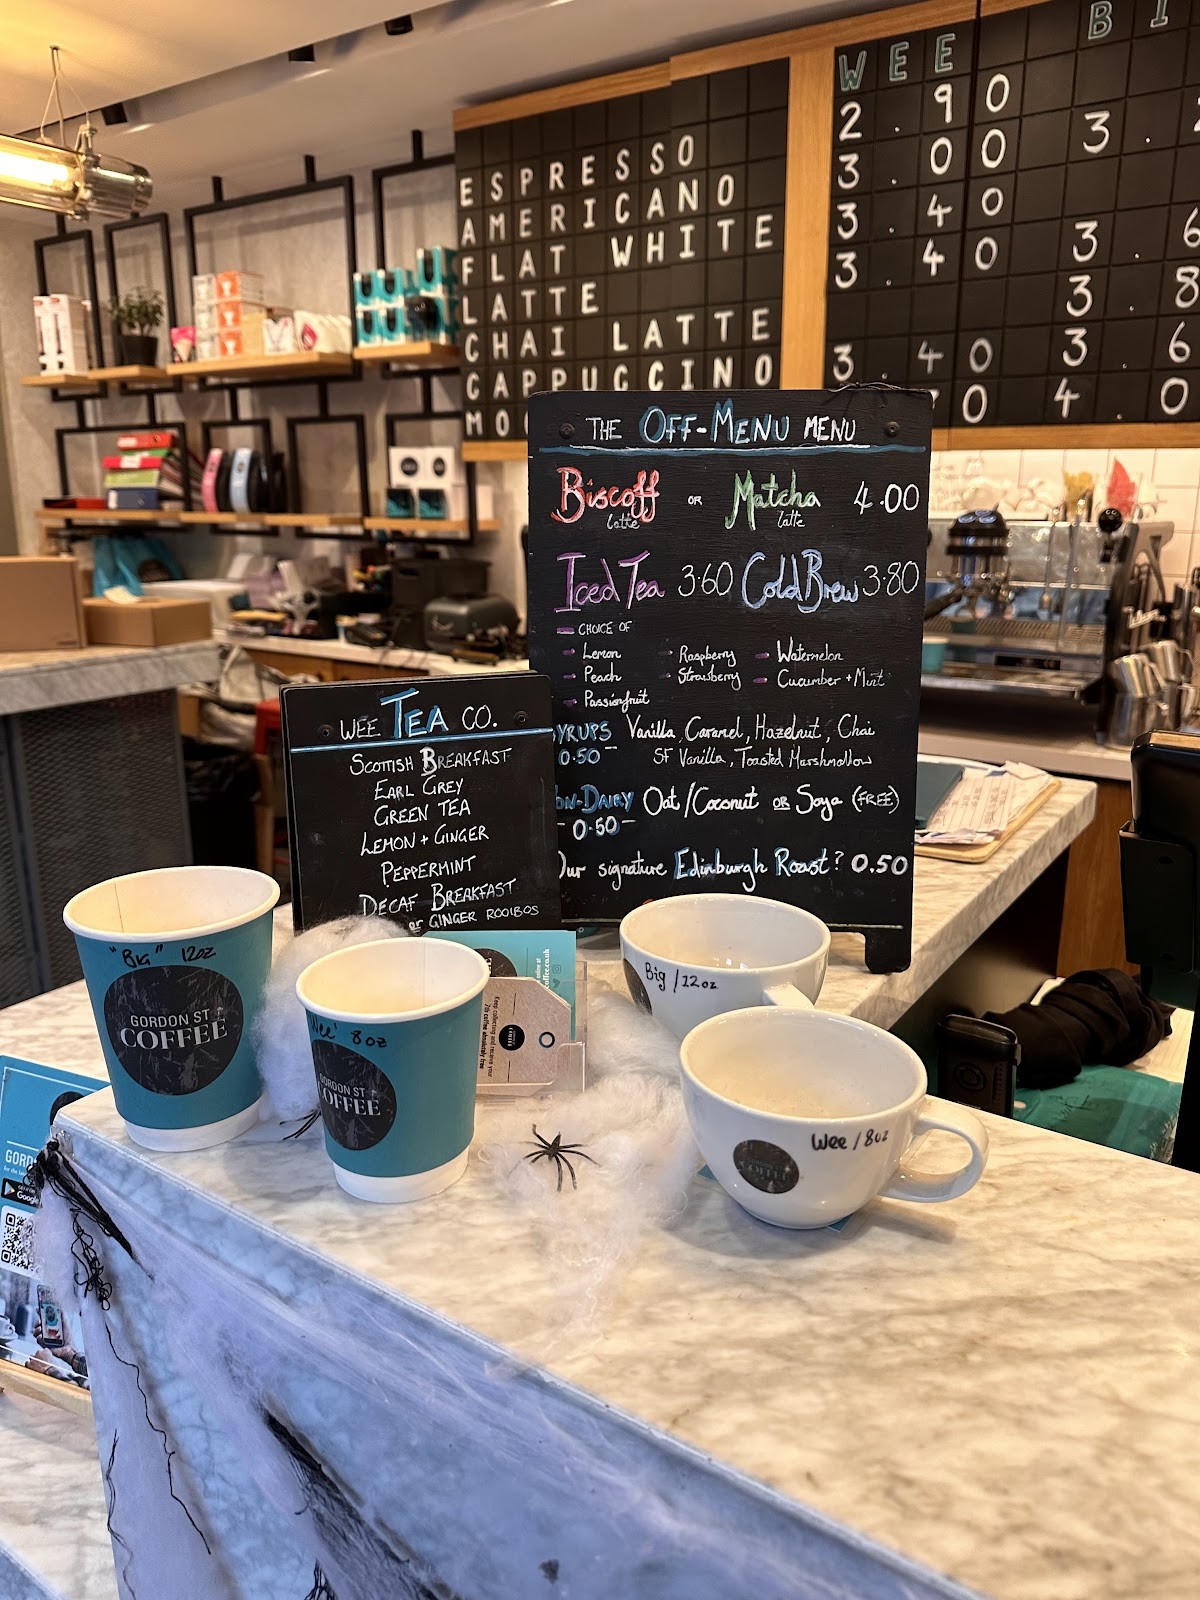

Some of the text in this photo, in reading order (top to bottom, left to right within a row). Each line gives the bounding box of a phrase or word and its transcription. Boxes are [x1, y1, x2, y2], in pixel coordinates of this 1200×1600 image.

[838, 32, 957, 92] WEE
[838, 72, 1010, 142] 2.90
[459, 134, 695, 207] ESPRESSO
[837, 128, 1007, 190] 3.00
[461, 174, 735, 247] AMERICANO
[836, 187, 1004, 241] 3.40
[461, 213, 774, 284] FLAT WHITE
[834, 236, 999, 289] 3.40
[462, 281, 599, 325] LATTE
[464, 307, 771, 363] CHAI LATTE
[465, 353, 773, 400] CAPPUCCINO
[832, 336, 993, 382] 3.40
[584, 417, 623, 441] THE
[803, 415, 858, 442] MENU
[550, 465, 920, 531] Biscoff OR Matcha 4.00
[553, 548, 920, 614] Iced Tea 3.60 Cold Brew 3.80
[577, 620, 633, 636] CHOICE OF
[582, 637, 844, 667] Lemon Raspberry Watermelon
[583, 662, 622, 684] Peach
[677, 666, 742, 691] Strawberry
[777, 668, 842, 688] Cucumber
[340, 687, 498, 741] WEE TEA CO.
[584, 689, 650, 713] Passionfruit
[552, 720, 613, 744] YRUPS
[837, 714, 876, 739] Chai
[349, 746, 513, 777] SCOTTISH BREAKFAST
[653, 748, 670, 765] SF
[734, 745, 784, 768] Toasted
[789, 748, 872, 769] Marshmallow
[374, 774, 464, 800] EARL GREY
[773, 795, 791, 811] OR
[795, 784, 844, 821] Soya
[852, 784, 900, 814] (FREE)
[373, 798, 471, 827] GREEN TEA
[360, 831, 417, 857] LEMON
[433, 823, 490, 845] GINGER
[381, 855, 477, 888] PEPPERMINT
[598, 850, 668, 891] signature
[673, 848, 768, 893] Edinburgh
[851, 853, 908, 876] 0.50
[358, 878, 517, 918] DECAF BREAKFAST
[428, 912, 477, 930] GINGER
[486, 904, 540, 920] ROOIBOS
[645, 962, 666, 992] Big
[120, 1018, 229, 1051] COFFEE
[130, 1008, 210, 1028] GORDON ST
[319, 1072, 366, 1098] GORDON ST
[811, 1133, 848, 1151] Wee
